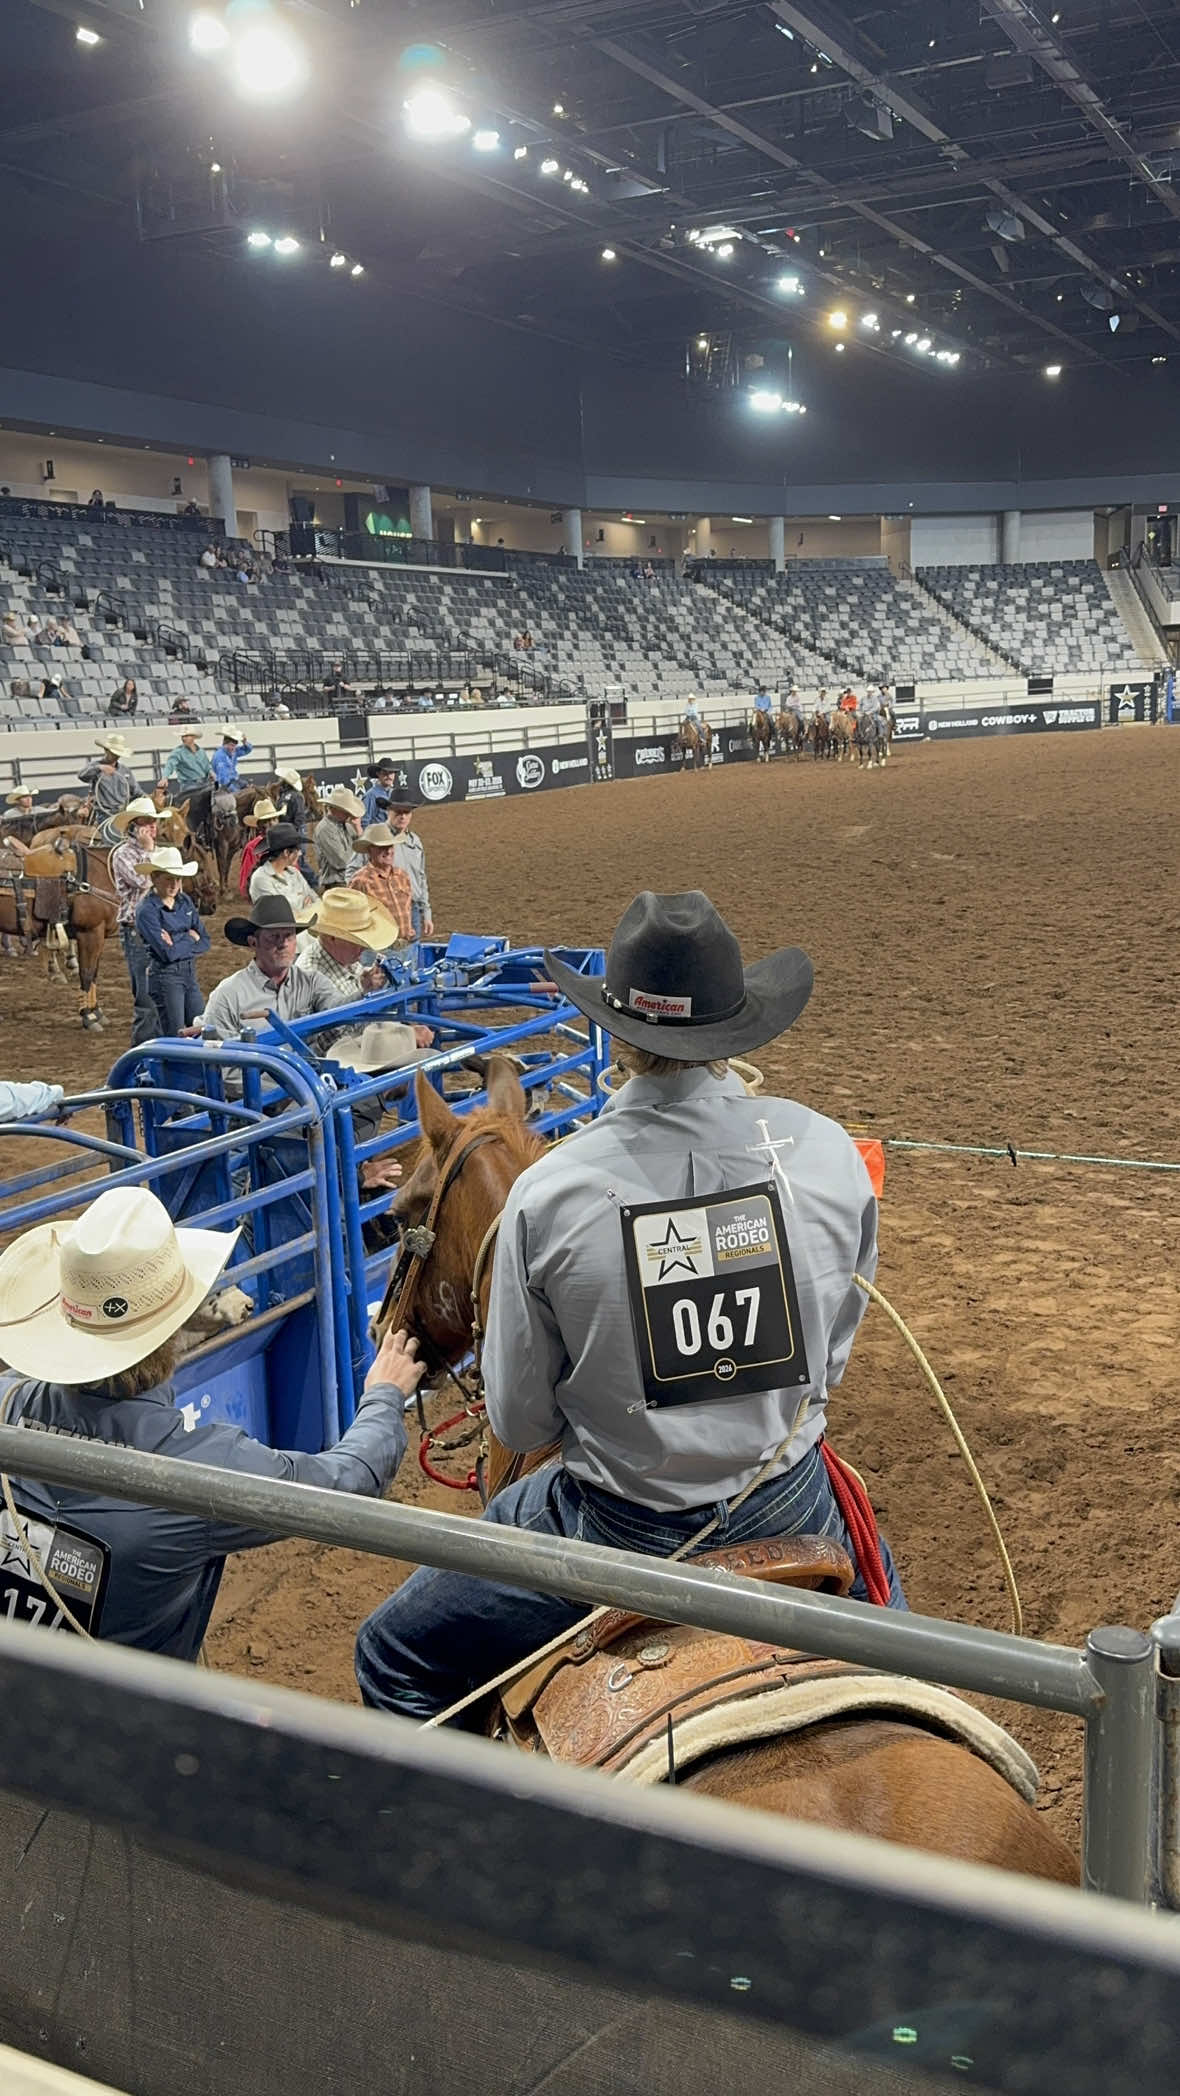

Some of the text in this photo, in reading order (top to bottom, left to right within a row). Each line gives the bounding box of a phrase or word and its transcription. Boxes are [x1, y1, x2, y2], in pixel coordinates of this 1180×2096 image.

[981, 714, 1037, 727] COWBOY+
[426, 771, 445, 787] FOX
[634, 996, 685, 1012] American
[715, 1217, 768, 1237] AMERICAN
[716, 1228, 770, 1251] RODEO
[657, 1244, 692, 1256] CENTRAL
[725, 1245, 766, 1258] REGIONALS
[672, 1286, 760, 1356] 067
[54, 1549, 97, 1573] AMERICAN
[50, 1558, 94, 1583] RODEO
